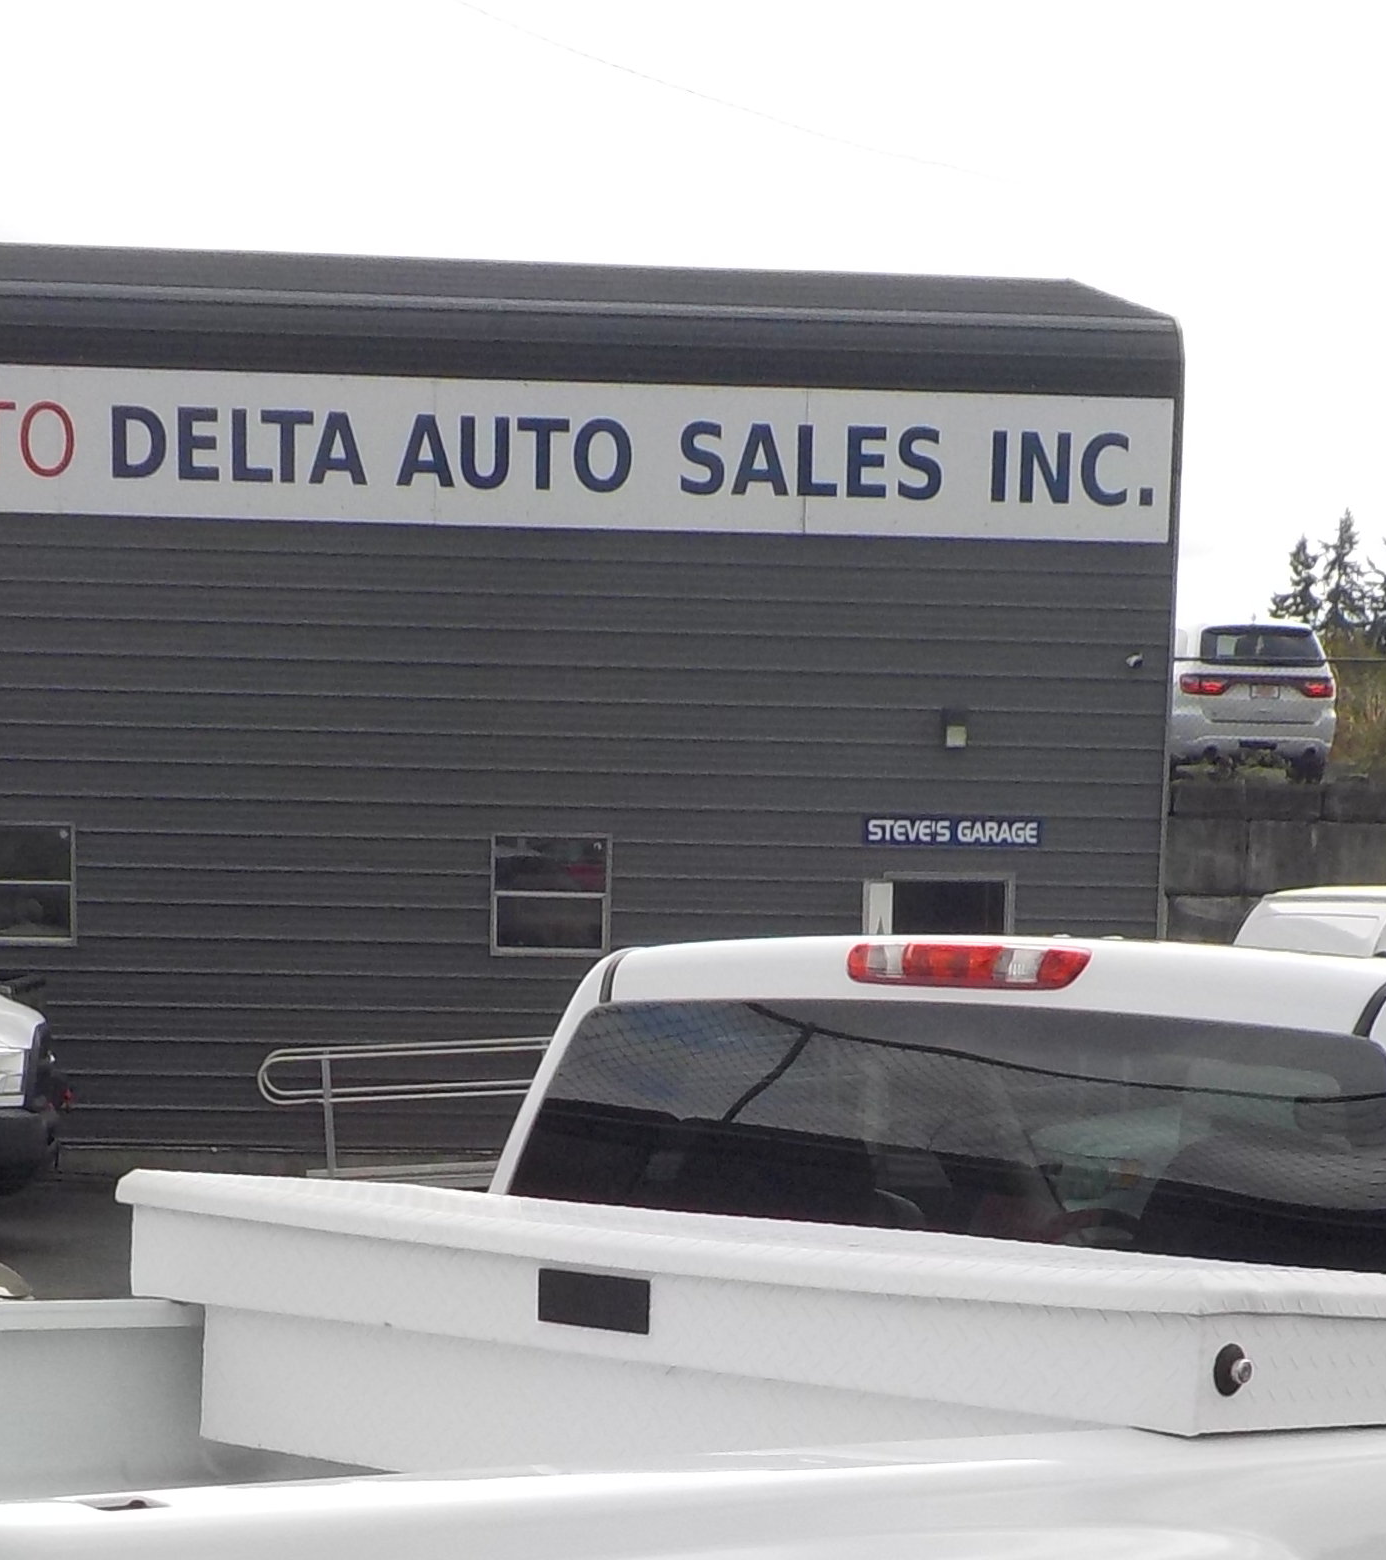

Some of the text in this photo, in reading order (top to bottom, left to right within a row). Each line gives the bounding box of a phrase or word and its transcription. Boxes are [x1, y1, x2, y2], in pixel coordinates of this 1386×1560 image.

[111, 405, 369, 486] DELTA
[396, 413, 633, 494] AUTO
[680, 420, 943, 501] SALES
[990, 430, 1154, 508] INC.
[868, 819, 1039, 844] STEVE'S GARAGE
